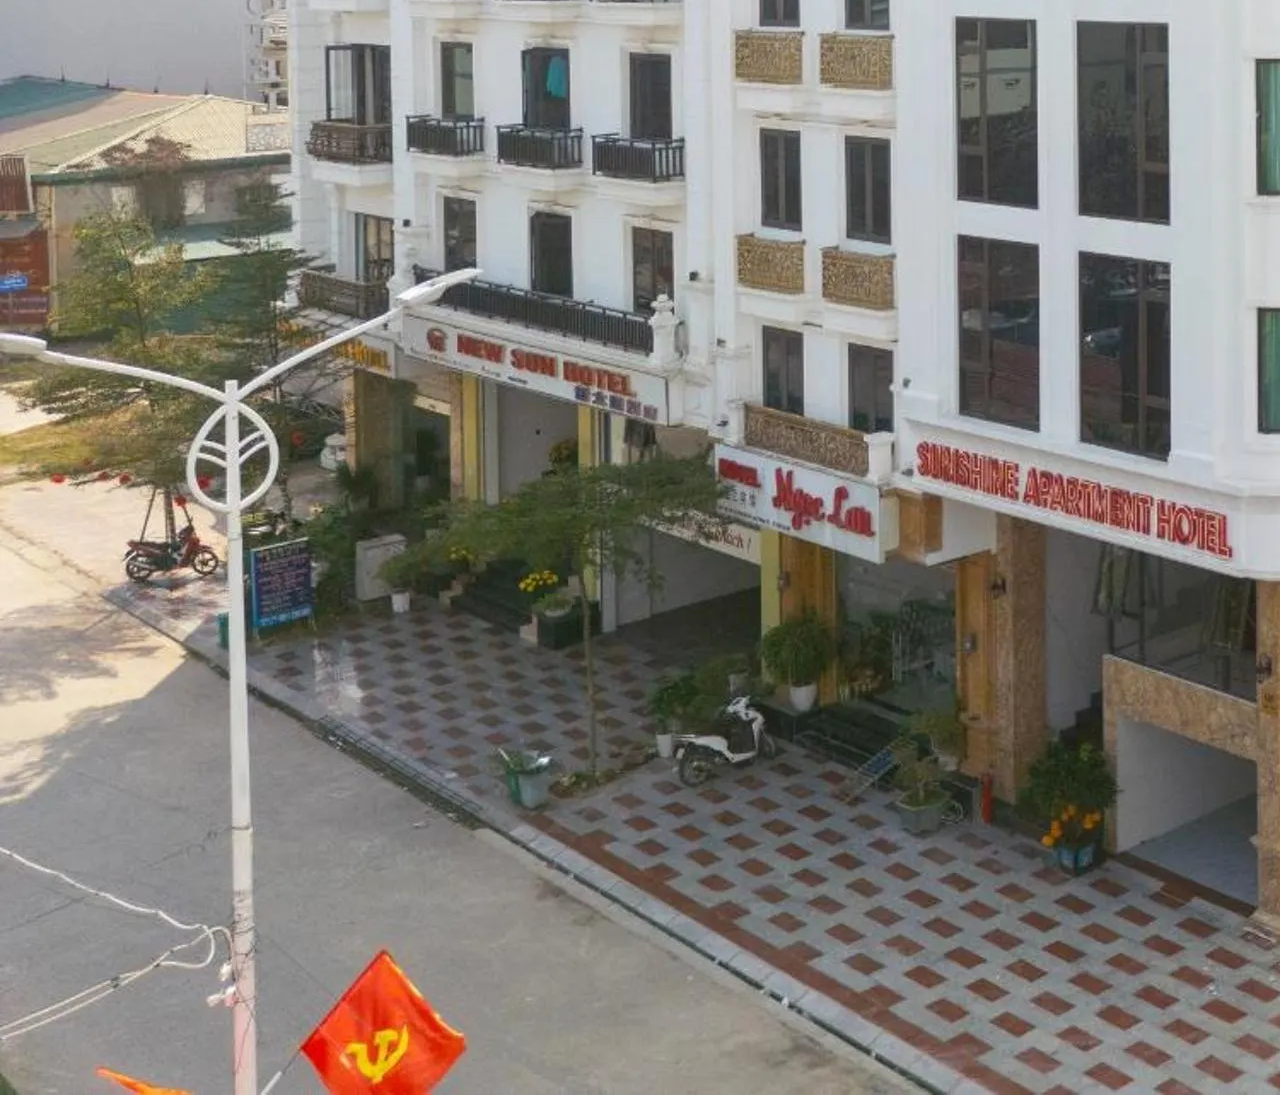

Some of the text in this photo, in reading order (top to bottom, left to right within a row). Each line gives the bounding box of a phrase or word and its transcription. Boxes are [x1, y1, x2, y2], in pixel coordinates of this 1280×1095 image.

[457, 332, 506, 364] NEW
[510, 348, 558, 378] SUN
[562, 360, 637, 398] HOTEL
[915, 439, 1234, 559] SUNSHINE APARTMENT HOTEL
